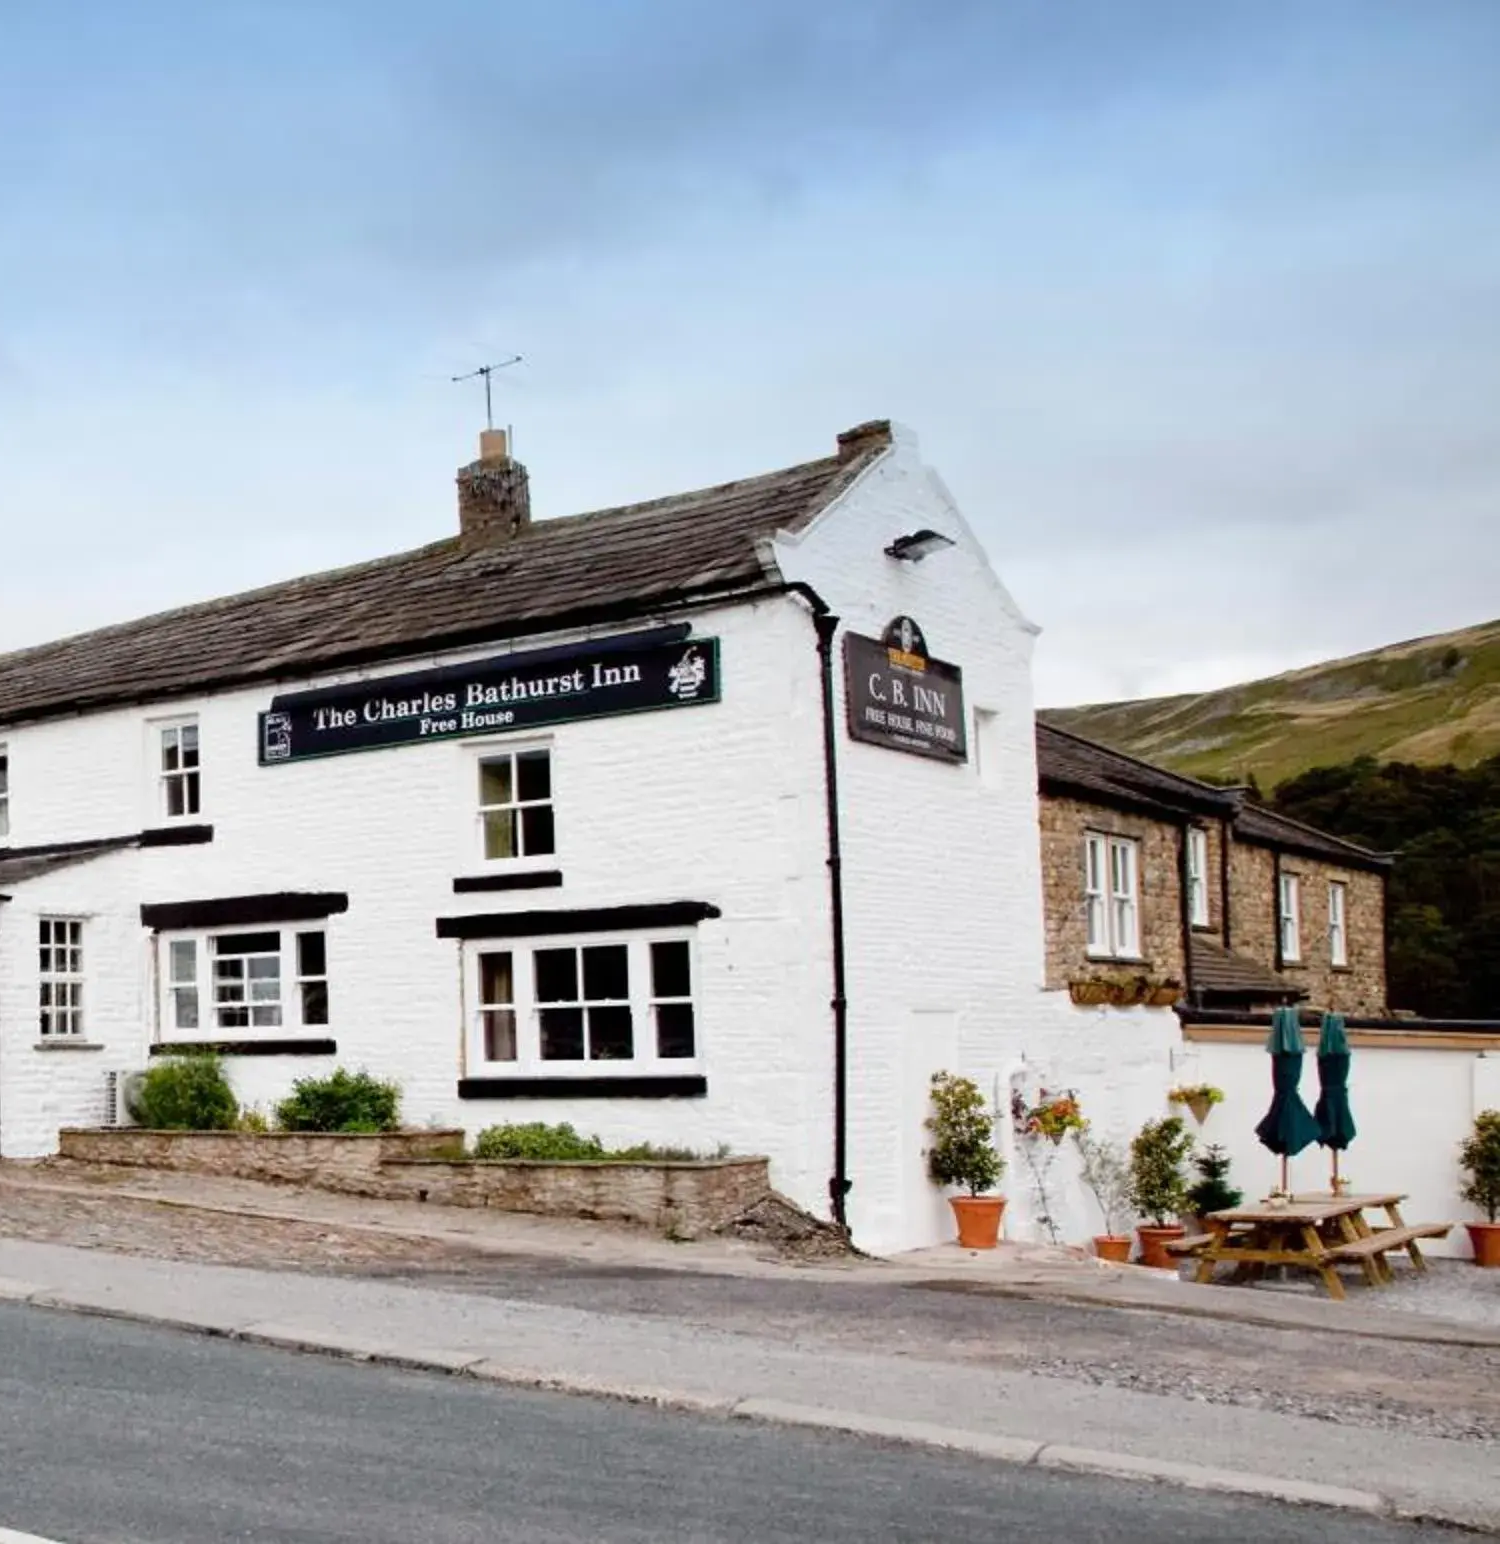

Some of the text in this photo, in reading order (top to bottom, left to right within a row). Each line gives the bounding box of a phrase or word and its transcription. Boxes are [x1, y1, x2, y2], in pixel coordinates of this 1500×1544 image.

[314, 663, 641, 731] The Charles Bathurst Inn
[913, 685, 945, 717] INN
[419, 709, 514, 735] Free House
